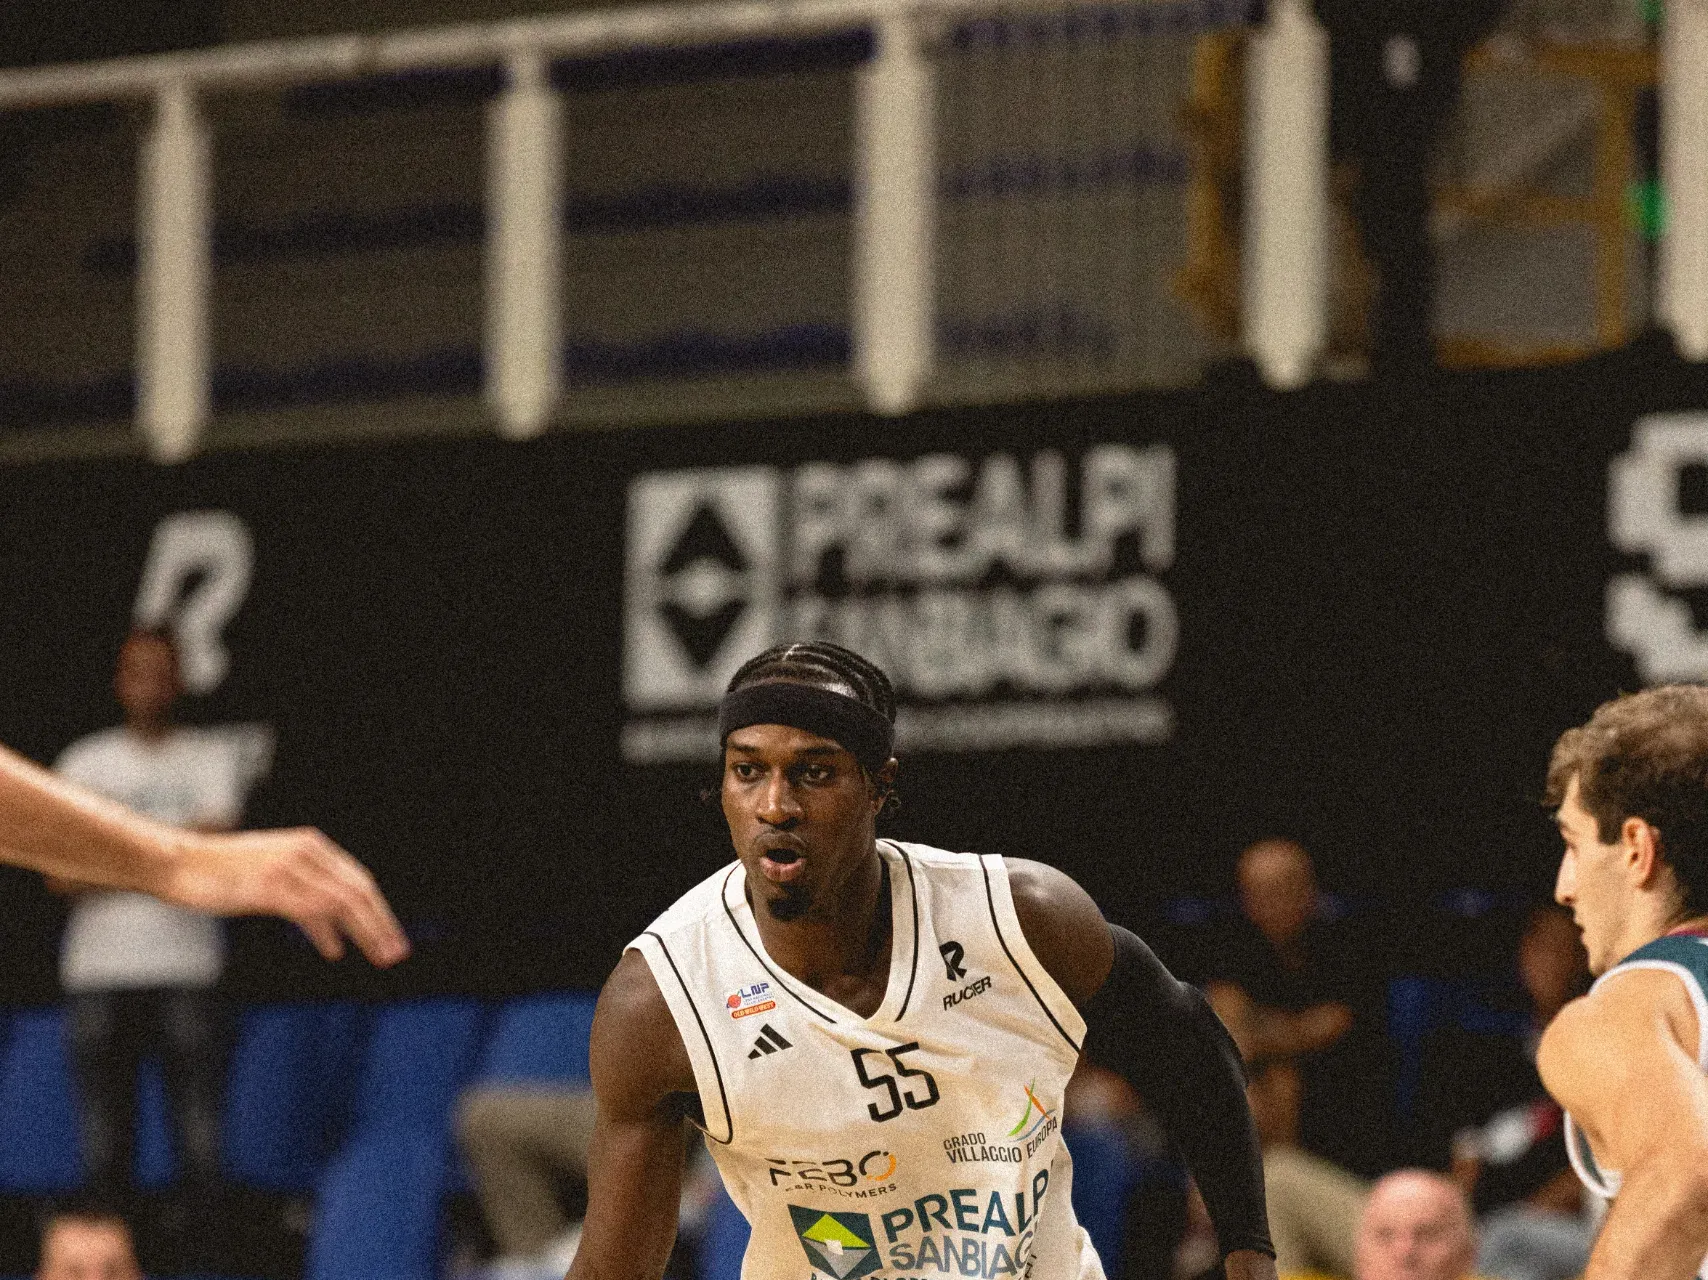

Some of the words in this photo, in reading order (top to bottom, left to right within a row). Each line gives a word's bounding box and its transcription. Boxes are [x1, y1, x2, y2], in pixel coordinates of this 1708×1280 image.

[741, 983, 769, 998] LNP
[733, 1010, 745, 1018] OLD
[745, 1005, 759, 1015] WILD
[759, 1001, 775, 1011] WEST
[850, 1041, 940, 1123] 55
[943, 1132, 986, 1151] GRADO
[1026, 1116, 1058, 1159] EUROPA
[764, 1150, 897, 1187] FEBO
[881, 1166, 1051, 1243] PREALP
